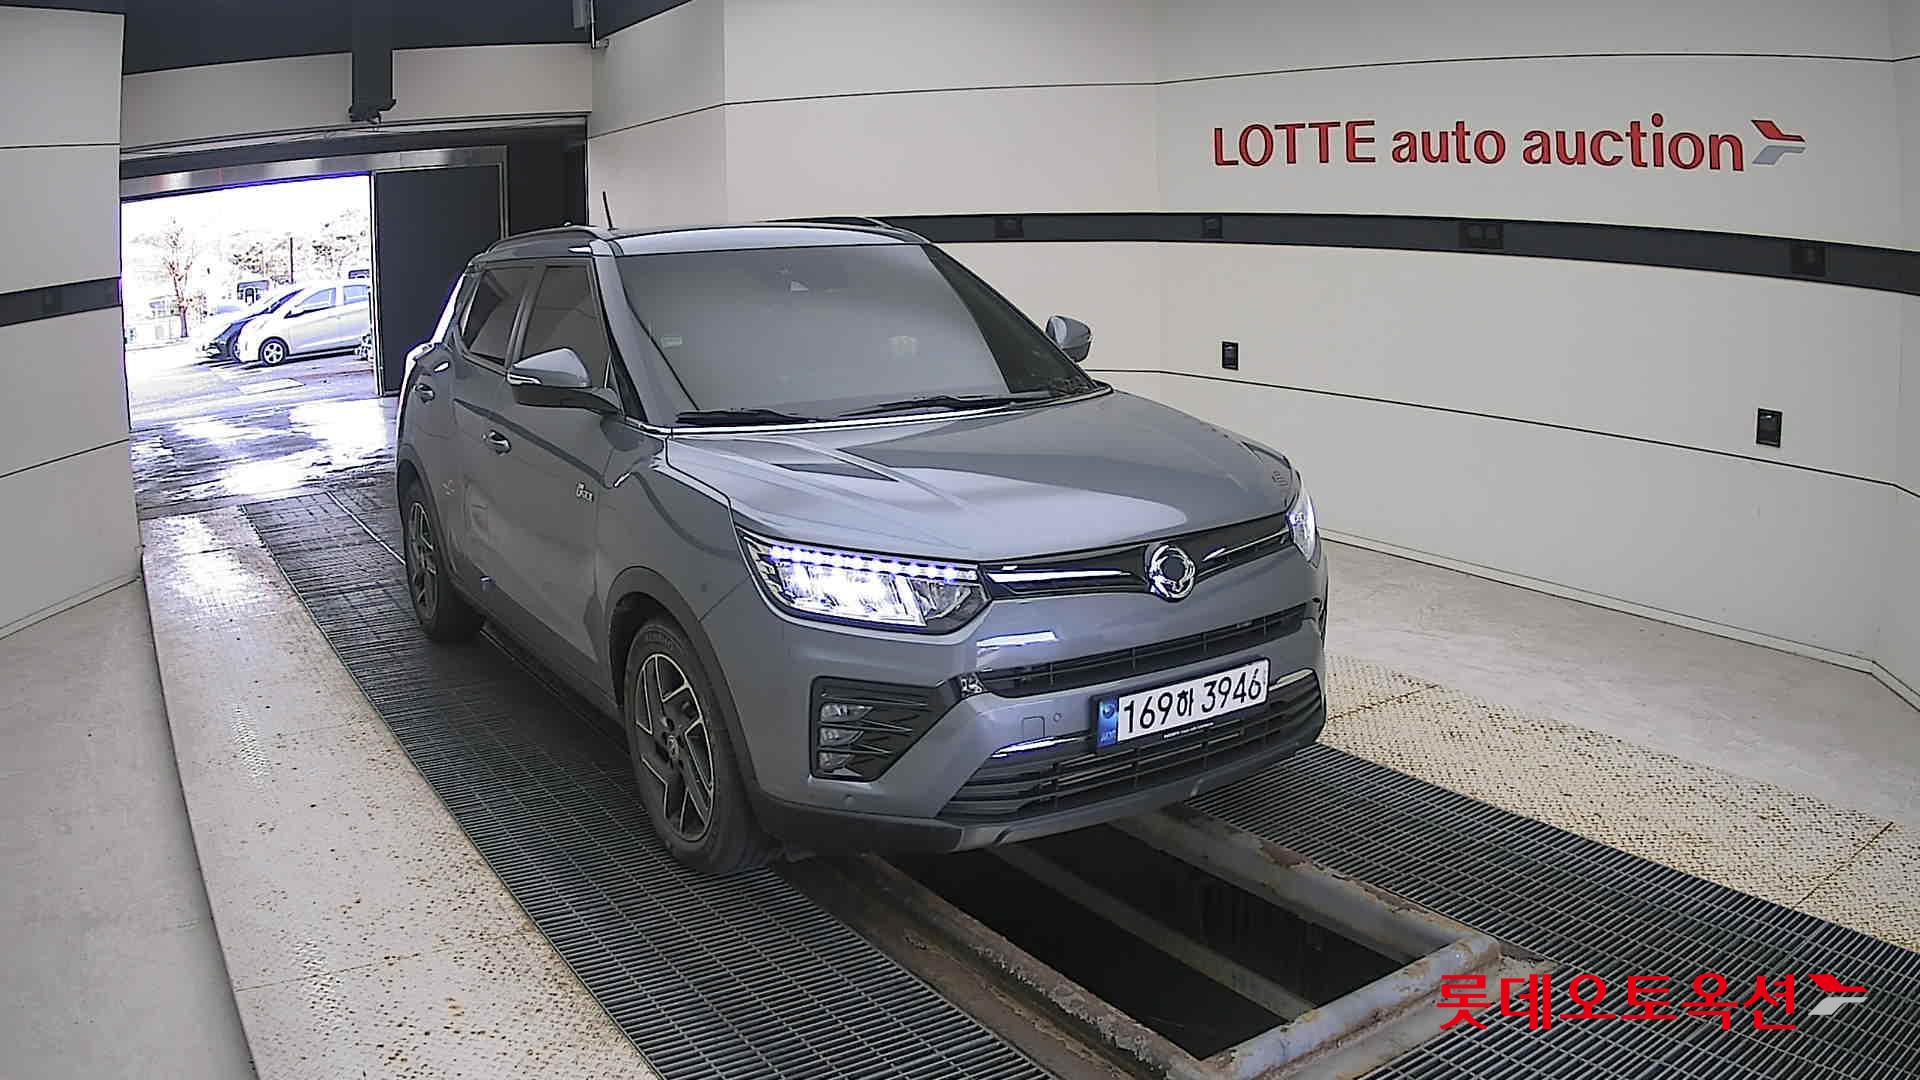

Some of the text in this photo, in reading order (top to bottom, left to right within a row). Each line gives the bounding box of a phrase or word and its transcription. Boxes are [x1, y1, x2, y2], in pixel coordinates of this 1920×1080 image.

[1213, 113, 1744, 172] LOTTE auto auction
[1123, 669, 1262, 733] 169하 3946
